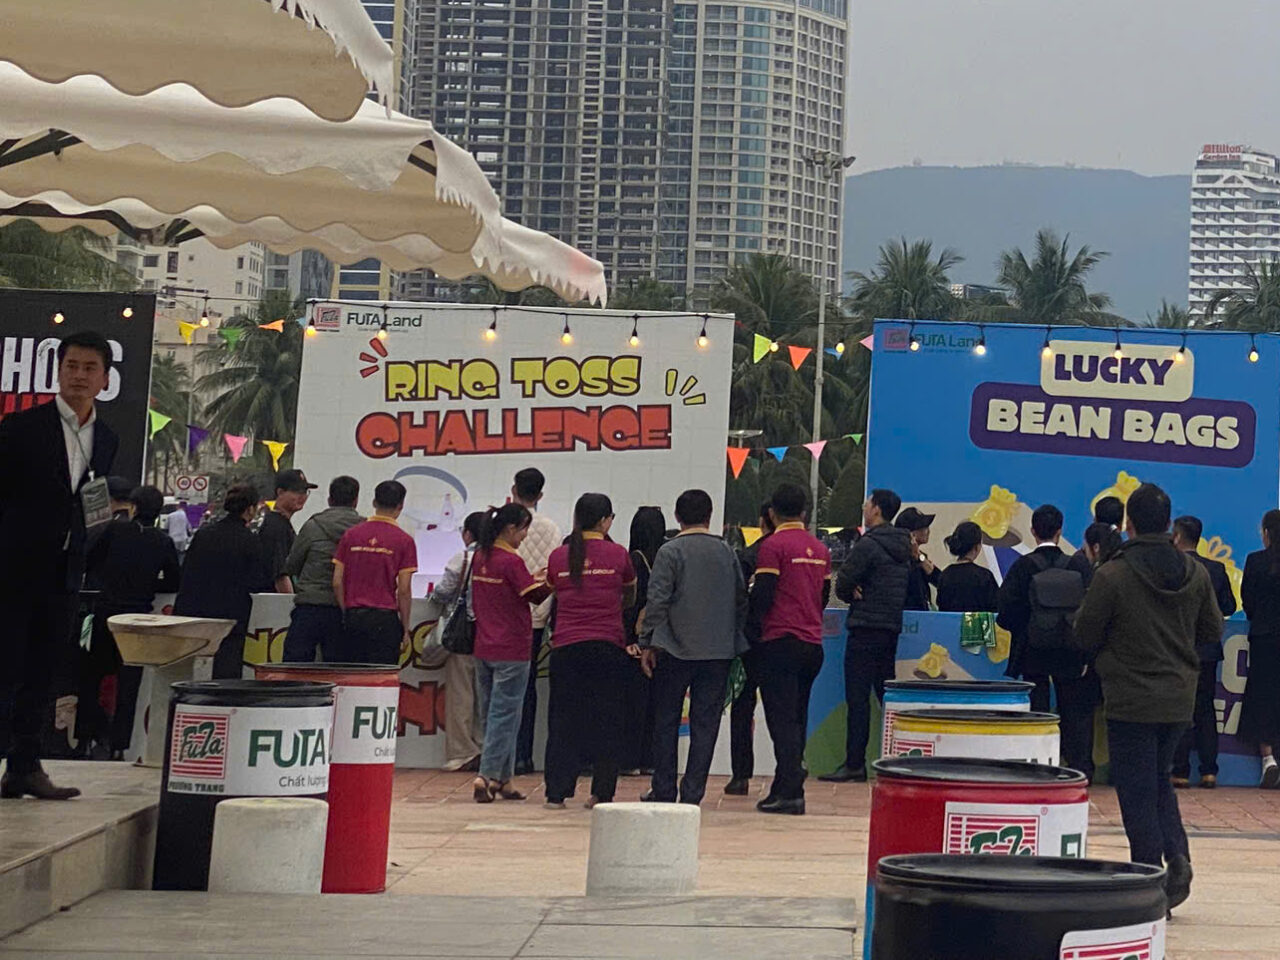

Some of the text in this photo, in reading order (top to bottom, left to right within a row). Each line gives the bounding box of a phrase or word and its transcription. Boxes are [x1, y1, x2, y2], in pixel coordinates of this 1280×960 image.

[347, 312, 423, 327] FUTA Land
[1, 336, 123, 402] HOS
[385, 355, 642, 402] RING TOSS
[1054, 353, 1174, 386] LUCKY
[356, 403, 672, 459] CHALLENGE
[986, 398, 1240, 450] BEAN BAGS
[248, 728, 327, 768] FUTA
